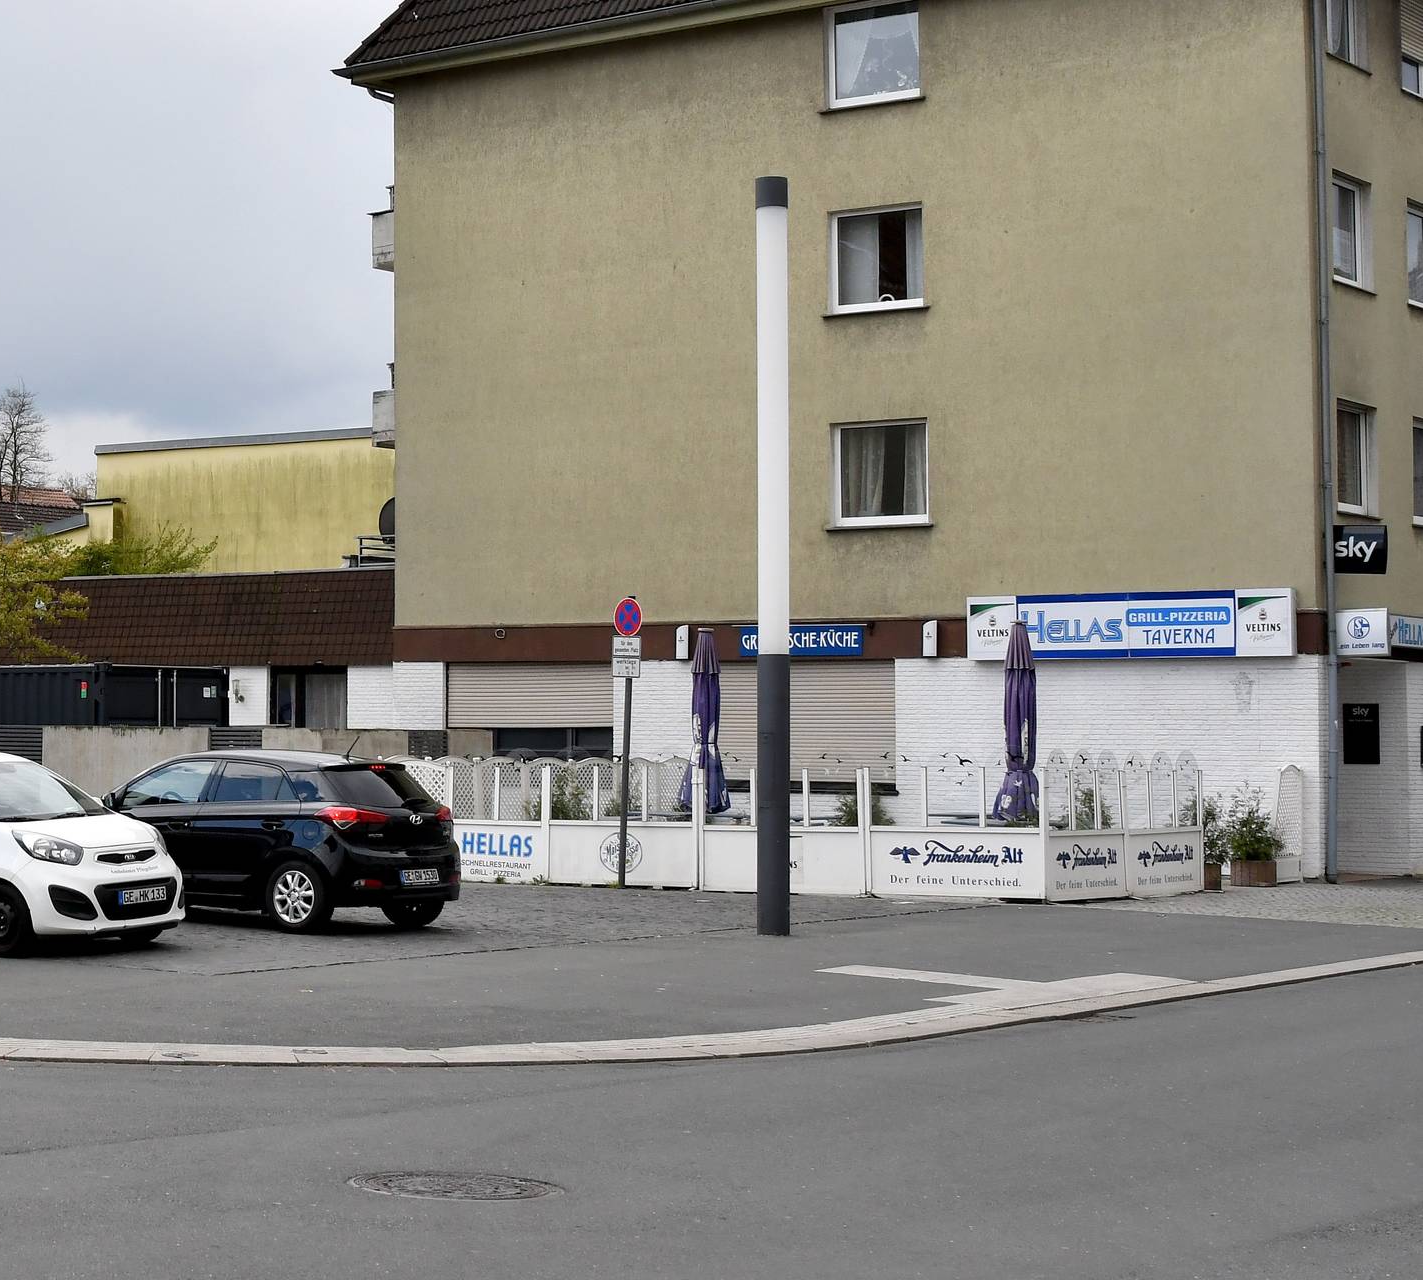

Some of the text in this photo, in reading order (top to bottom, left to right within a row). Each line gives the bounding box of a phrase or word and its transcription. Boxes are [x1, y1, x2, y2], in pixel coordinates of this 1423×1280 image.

[1335, 536, 1377, 562] sky
[1129, 611, 1227, 623] GRILL-PIZZERIA
[977, 629, 1009, 638] VELTINS
[1021, 610, 1123, 643] HELLAS
[1246, 623, 1282, 632] VELTINS
[1398, 618, 1423, 646] HELLA
[742, 629, 859, 651] GRSCHE-KÜCHE
[1143, 628, 1215, 645] TAVERNA
[1353, 706, 1370, 717] sky
[462, 832, 533, 858] HELLAS
[923, 840, 1024, 867] Frankenheim Alt
[1072, 844, 1117, 870] Frankenheim Alt
[1152, 841, 1194, 867] Frankenheim Alt
[461, 860, 532, 870] SCHNELLRESTAURANT
[405, 871, 413, 882] GE
[493, 870, 522, 878] PIZZERIA
[890, 875, 1022, 887] Der feine Unterschied.
[1138, 873, 1194, 886] Der feine Unterschied.
[1056, 878, 1119, 890] Der feine Unterschied.
[124, 888, 166, 904] GE HK 133
